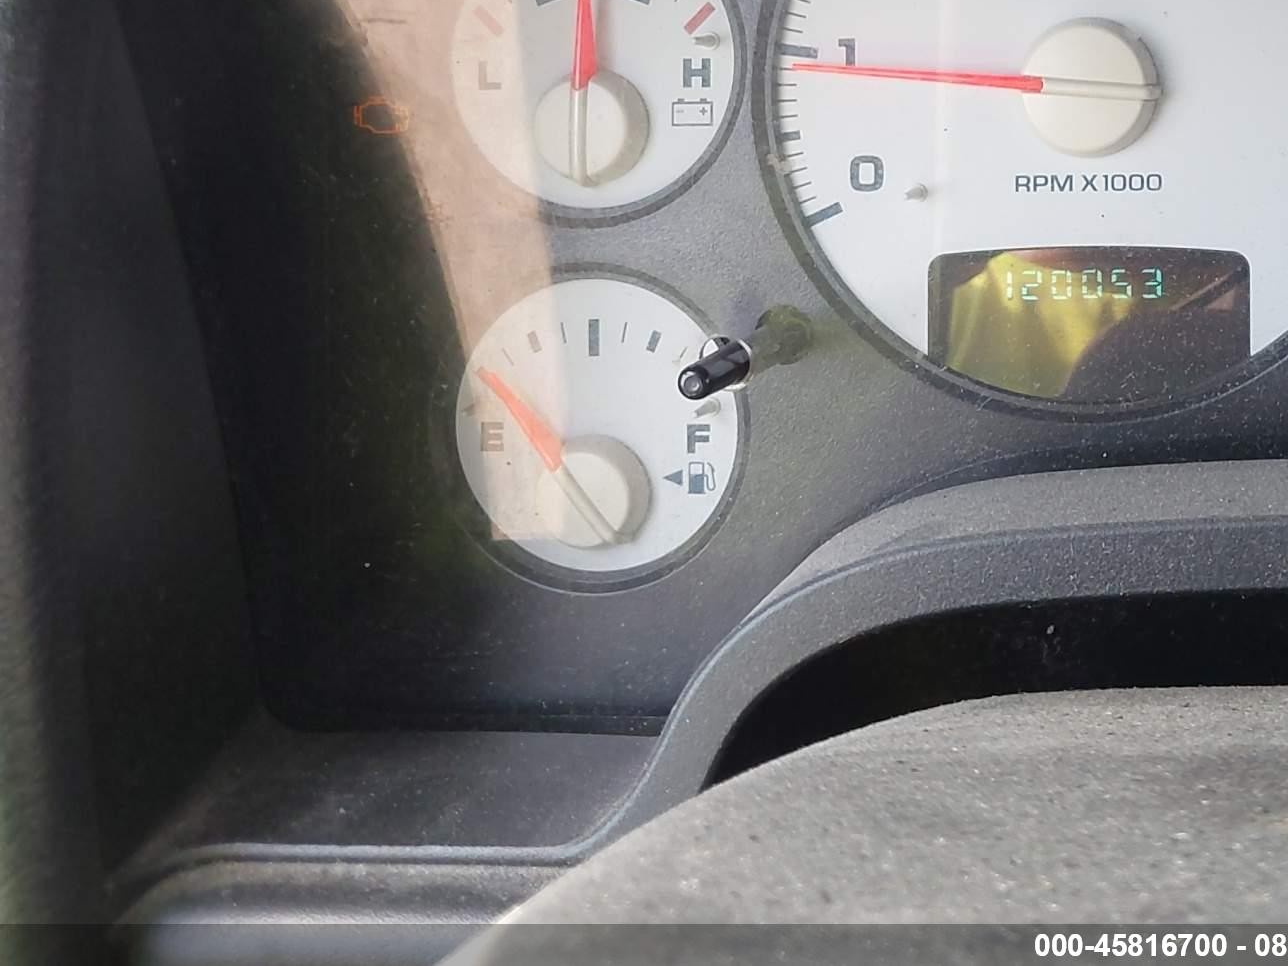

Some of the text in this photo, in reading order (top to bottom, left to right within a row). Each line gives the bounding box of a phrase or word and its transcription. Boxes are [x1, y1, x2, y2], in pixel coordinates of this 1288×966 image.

[838, 38, 856, 67] 1
[479, 60, 501, 90] L
[682, 58, 711, 88] H
[850, 155, 885, 192] 0
[1015, 173, 1074, 193] RPM
[1006, 268, 1164, 301] 120053
[480, 422, 505, 453] E
[687, 424, 711, 453] F
